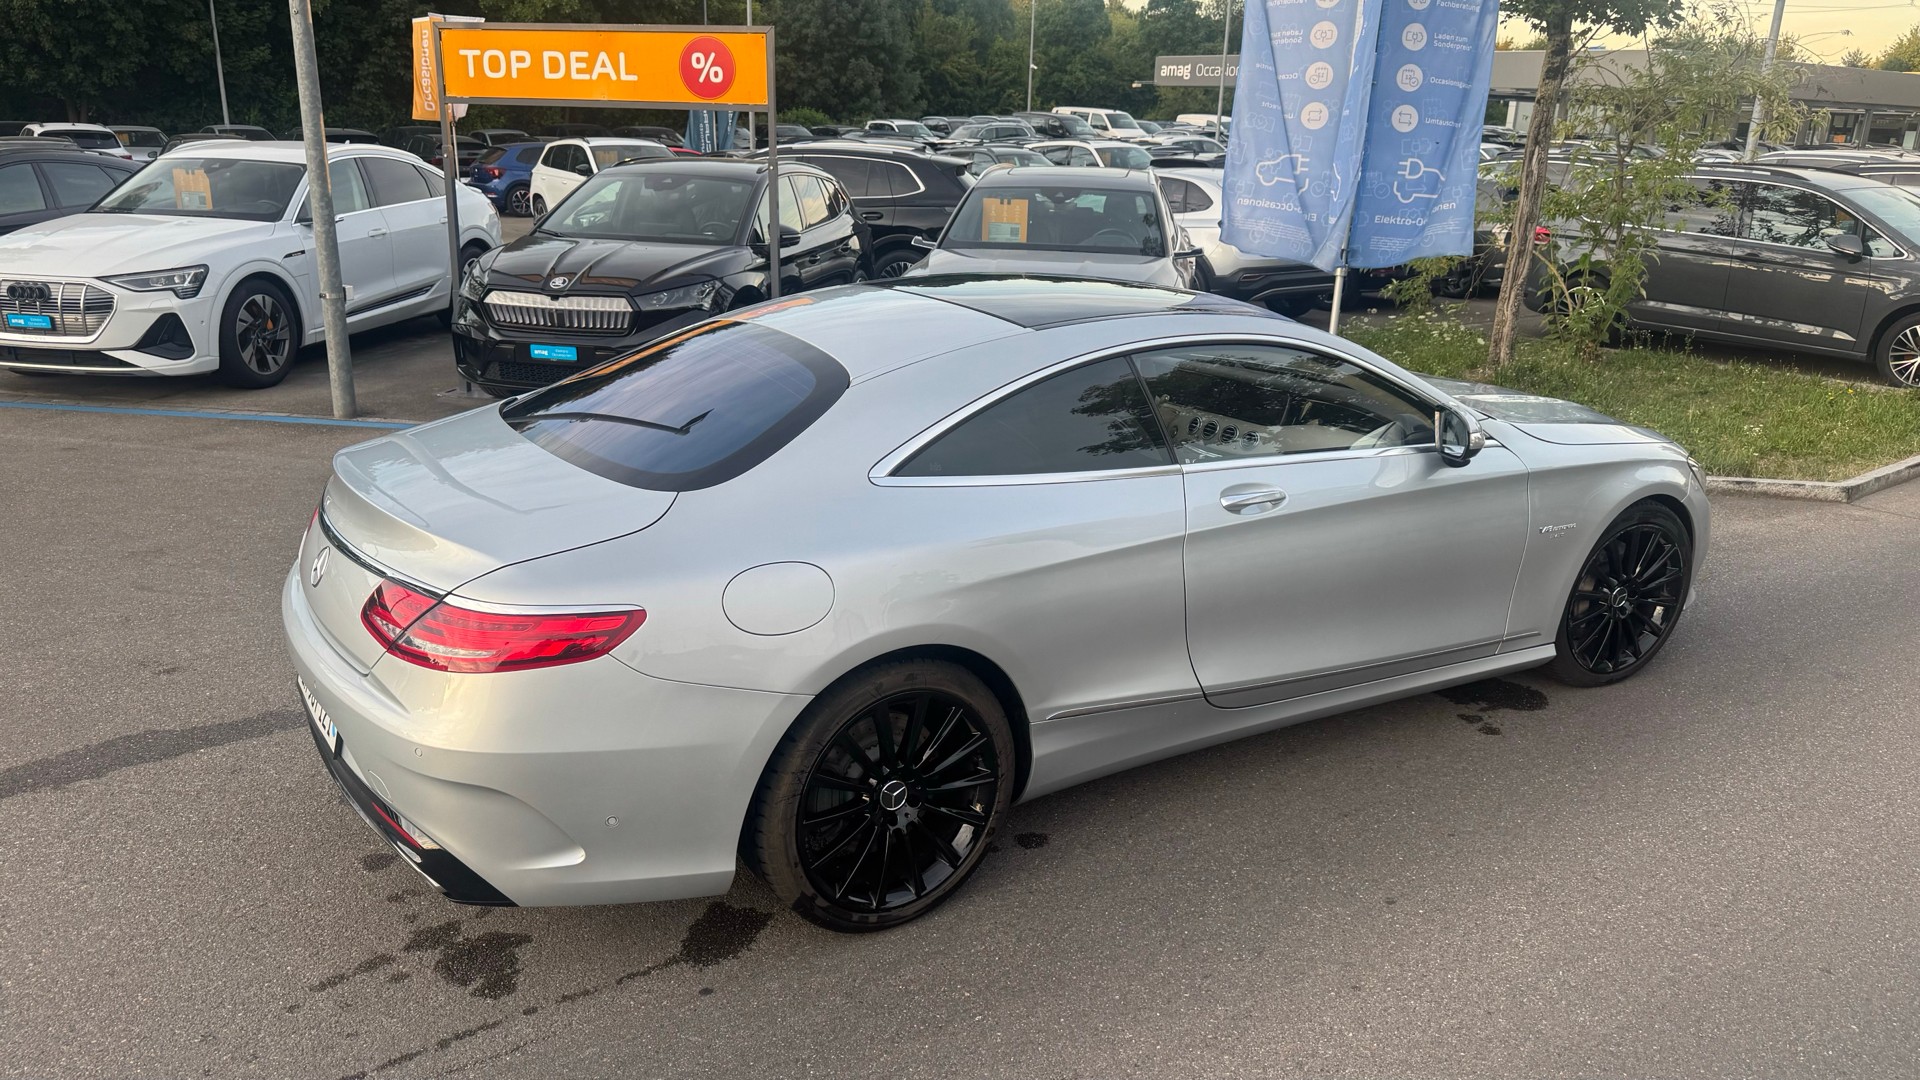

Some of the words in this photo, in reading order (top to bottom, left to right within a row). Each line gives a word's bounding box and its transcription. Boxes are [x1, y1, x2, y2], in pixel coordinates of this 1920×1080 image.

[1434, 32, 1455, 41] Laden
[459, 49, 531, 79] TOP
[542, 51, 639, 81] DEAL
[691, 52, 724, 84] %
[1160, 63, 1192, 80] amag
